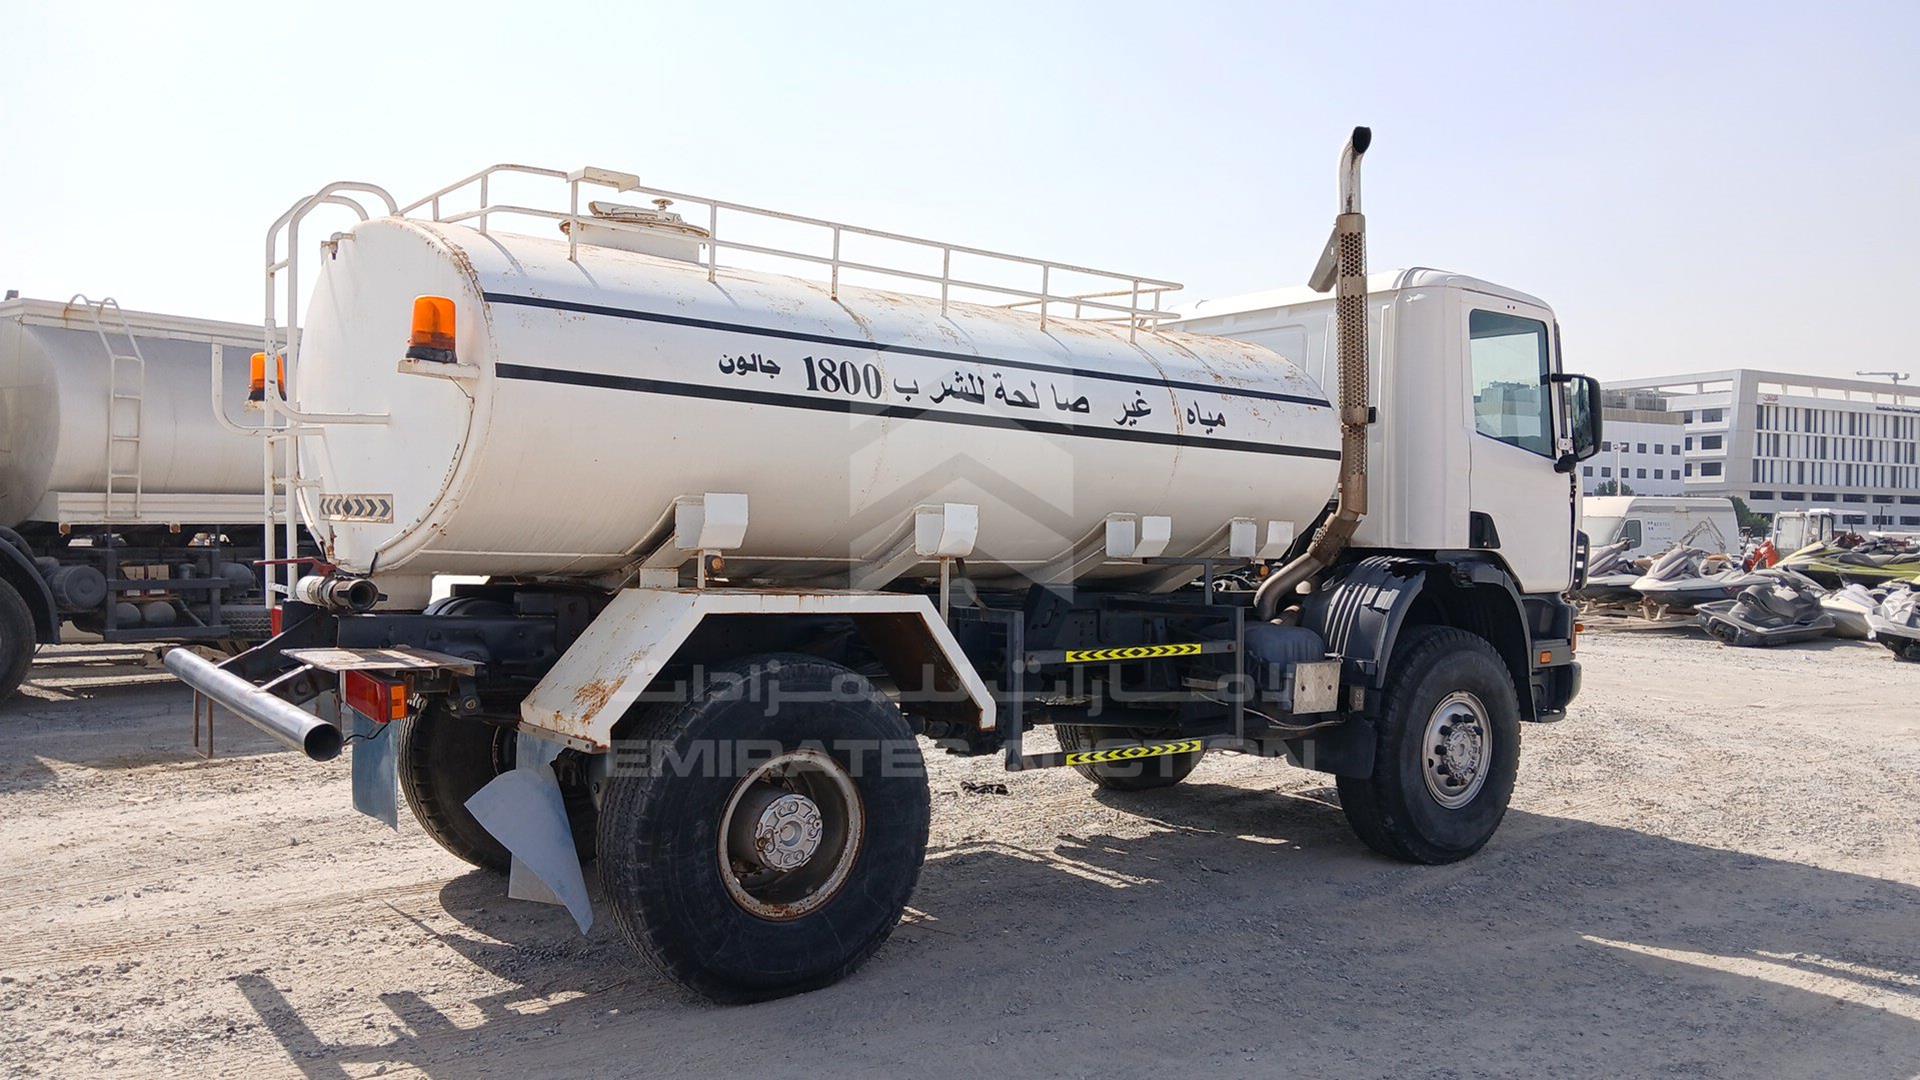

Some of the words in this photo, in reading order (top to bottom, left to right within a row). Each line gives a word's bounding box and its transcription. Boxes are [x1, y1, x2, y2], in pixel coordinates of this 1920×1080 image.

[719, 353, 781, 379] جالون
[803, 356, 882, 399] 1800
[1113, 389, 1152, 426] غير
[1187, 399, 1226, 434] مياه
